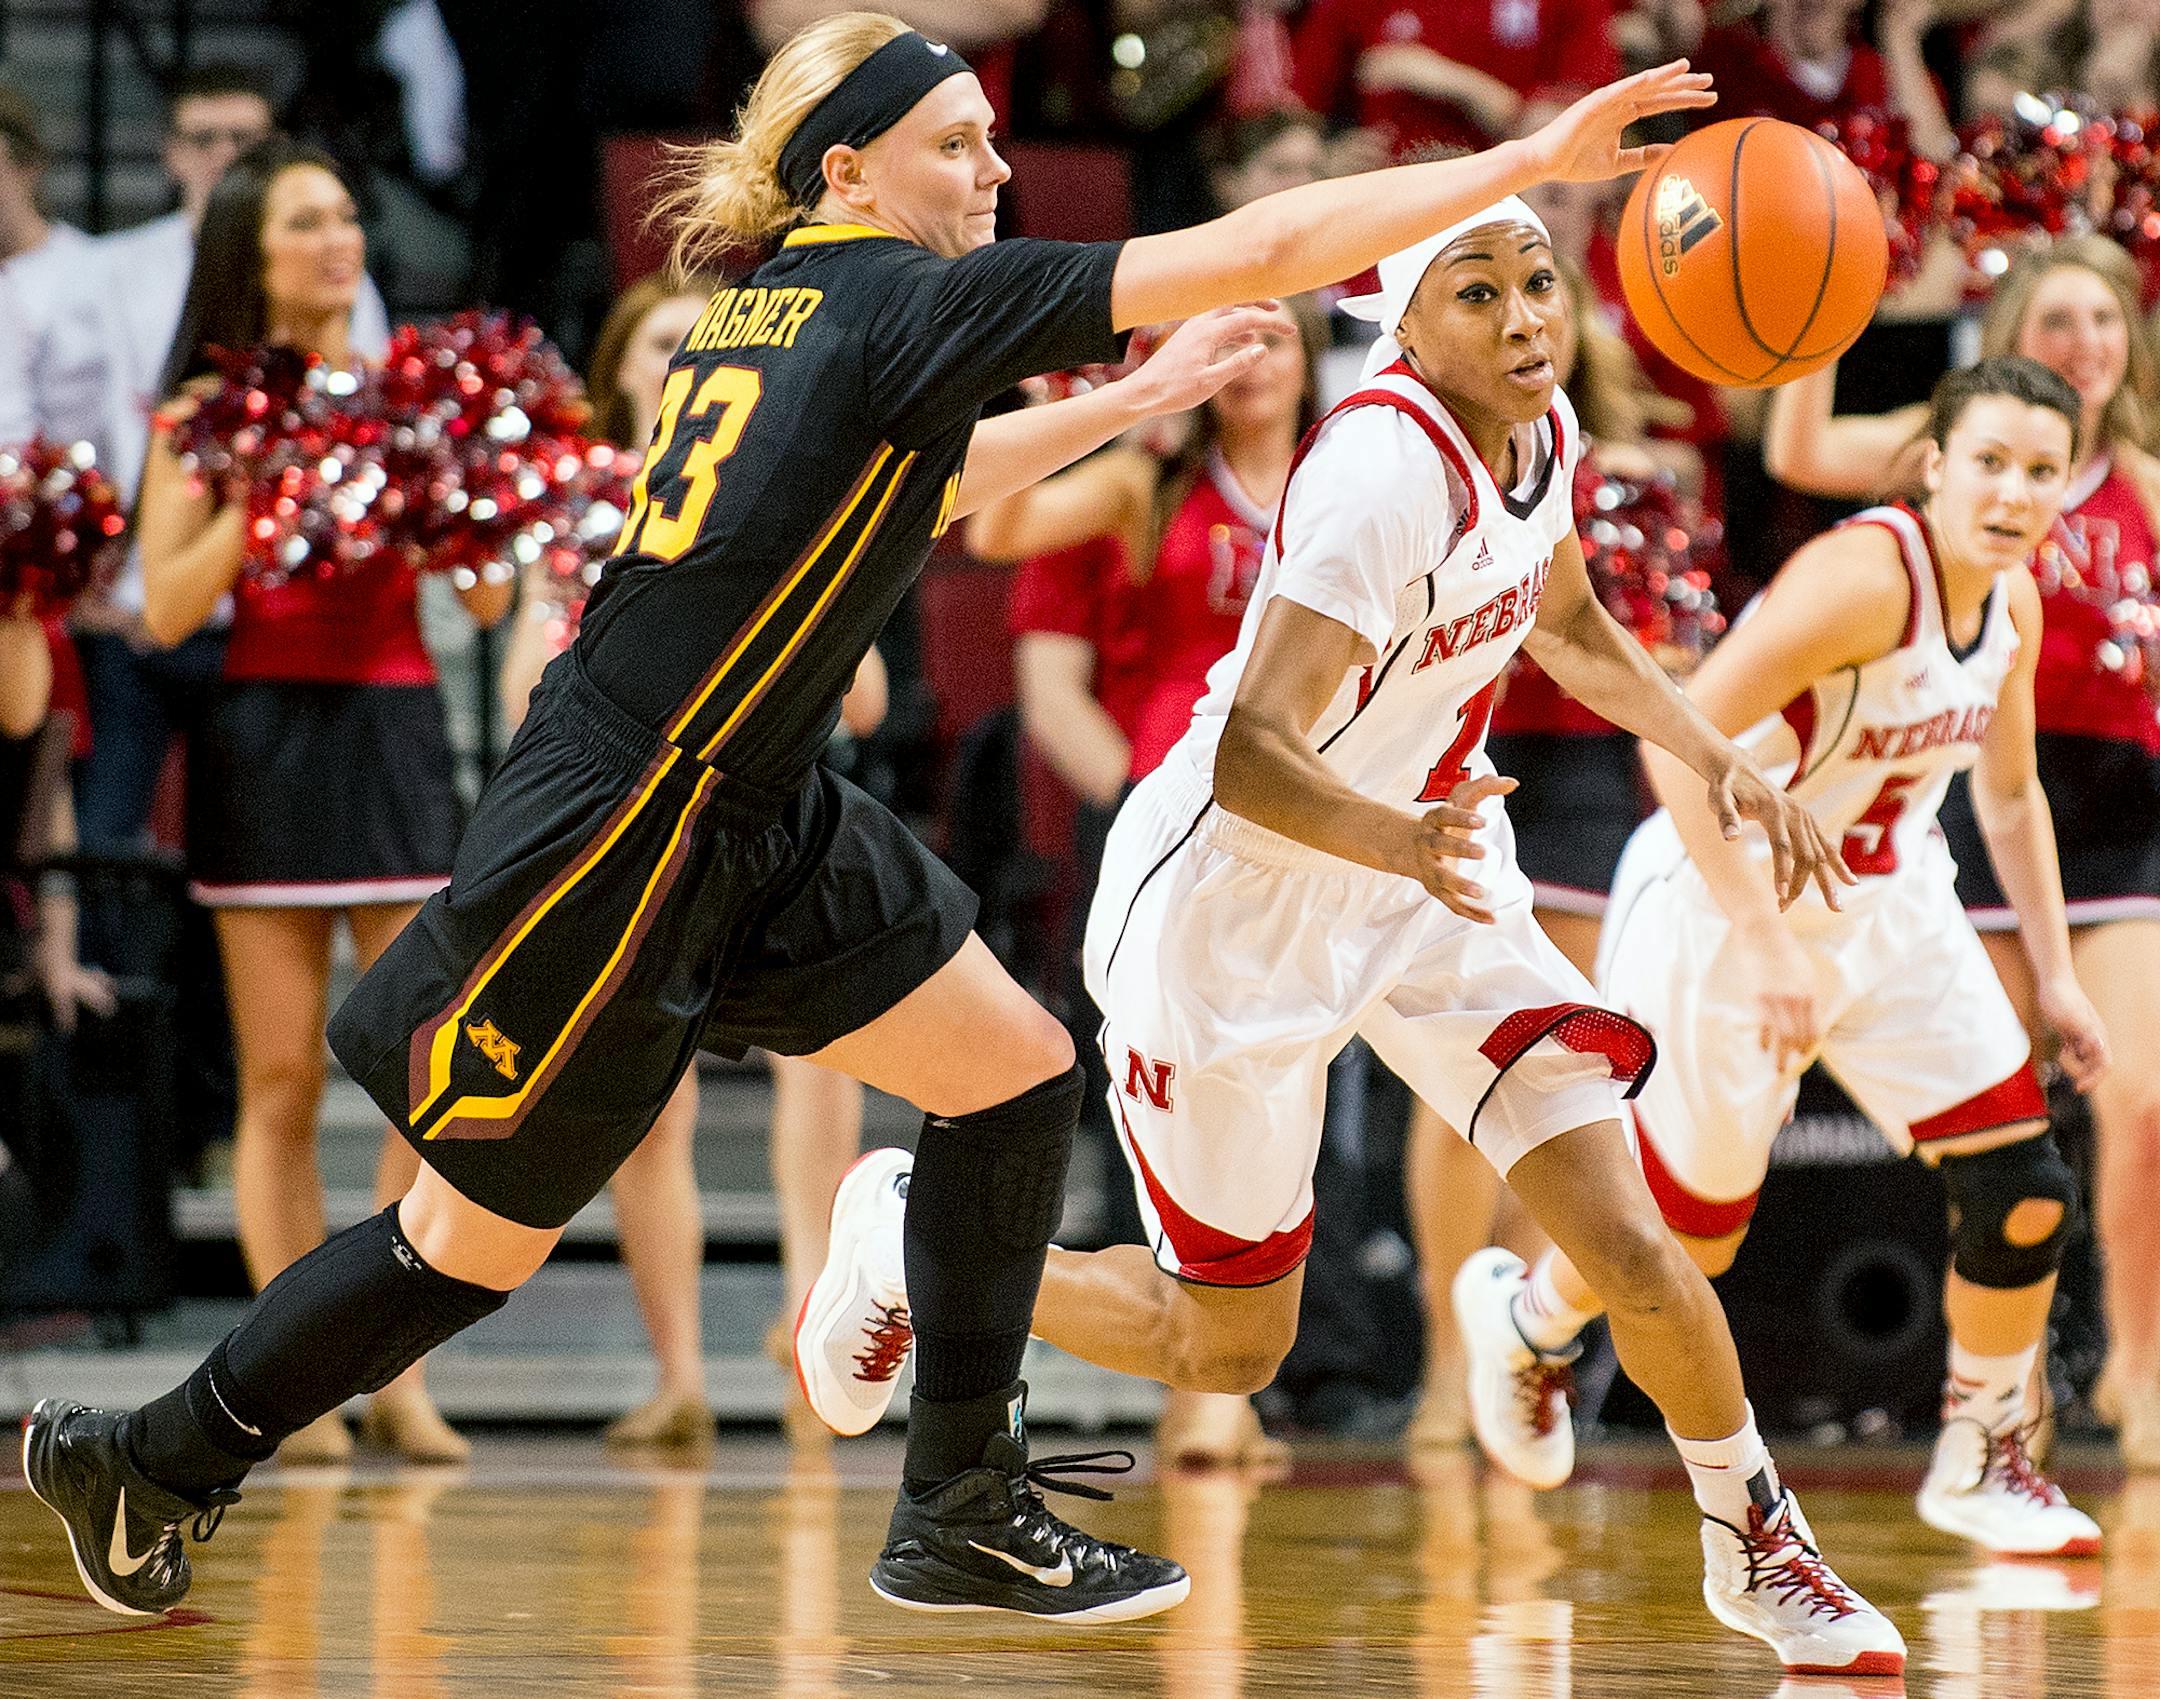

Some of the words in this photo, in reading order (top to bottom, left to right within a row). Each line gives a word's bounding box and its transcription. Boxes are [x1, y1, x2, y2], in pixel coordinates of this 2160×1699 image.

[685, 286, 824, 352] WAGNER
[1840, 772, 1928, 877] 5
[1123, 1044, 1176, 1114] N
